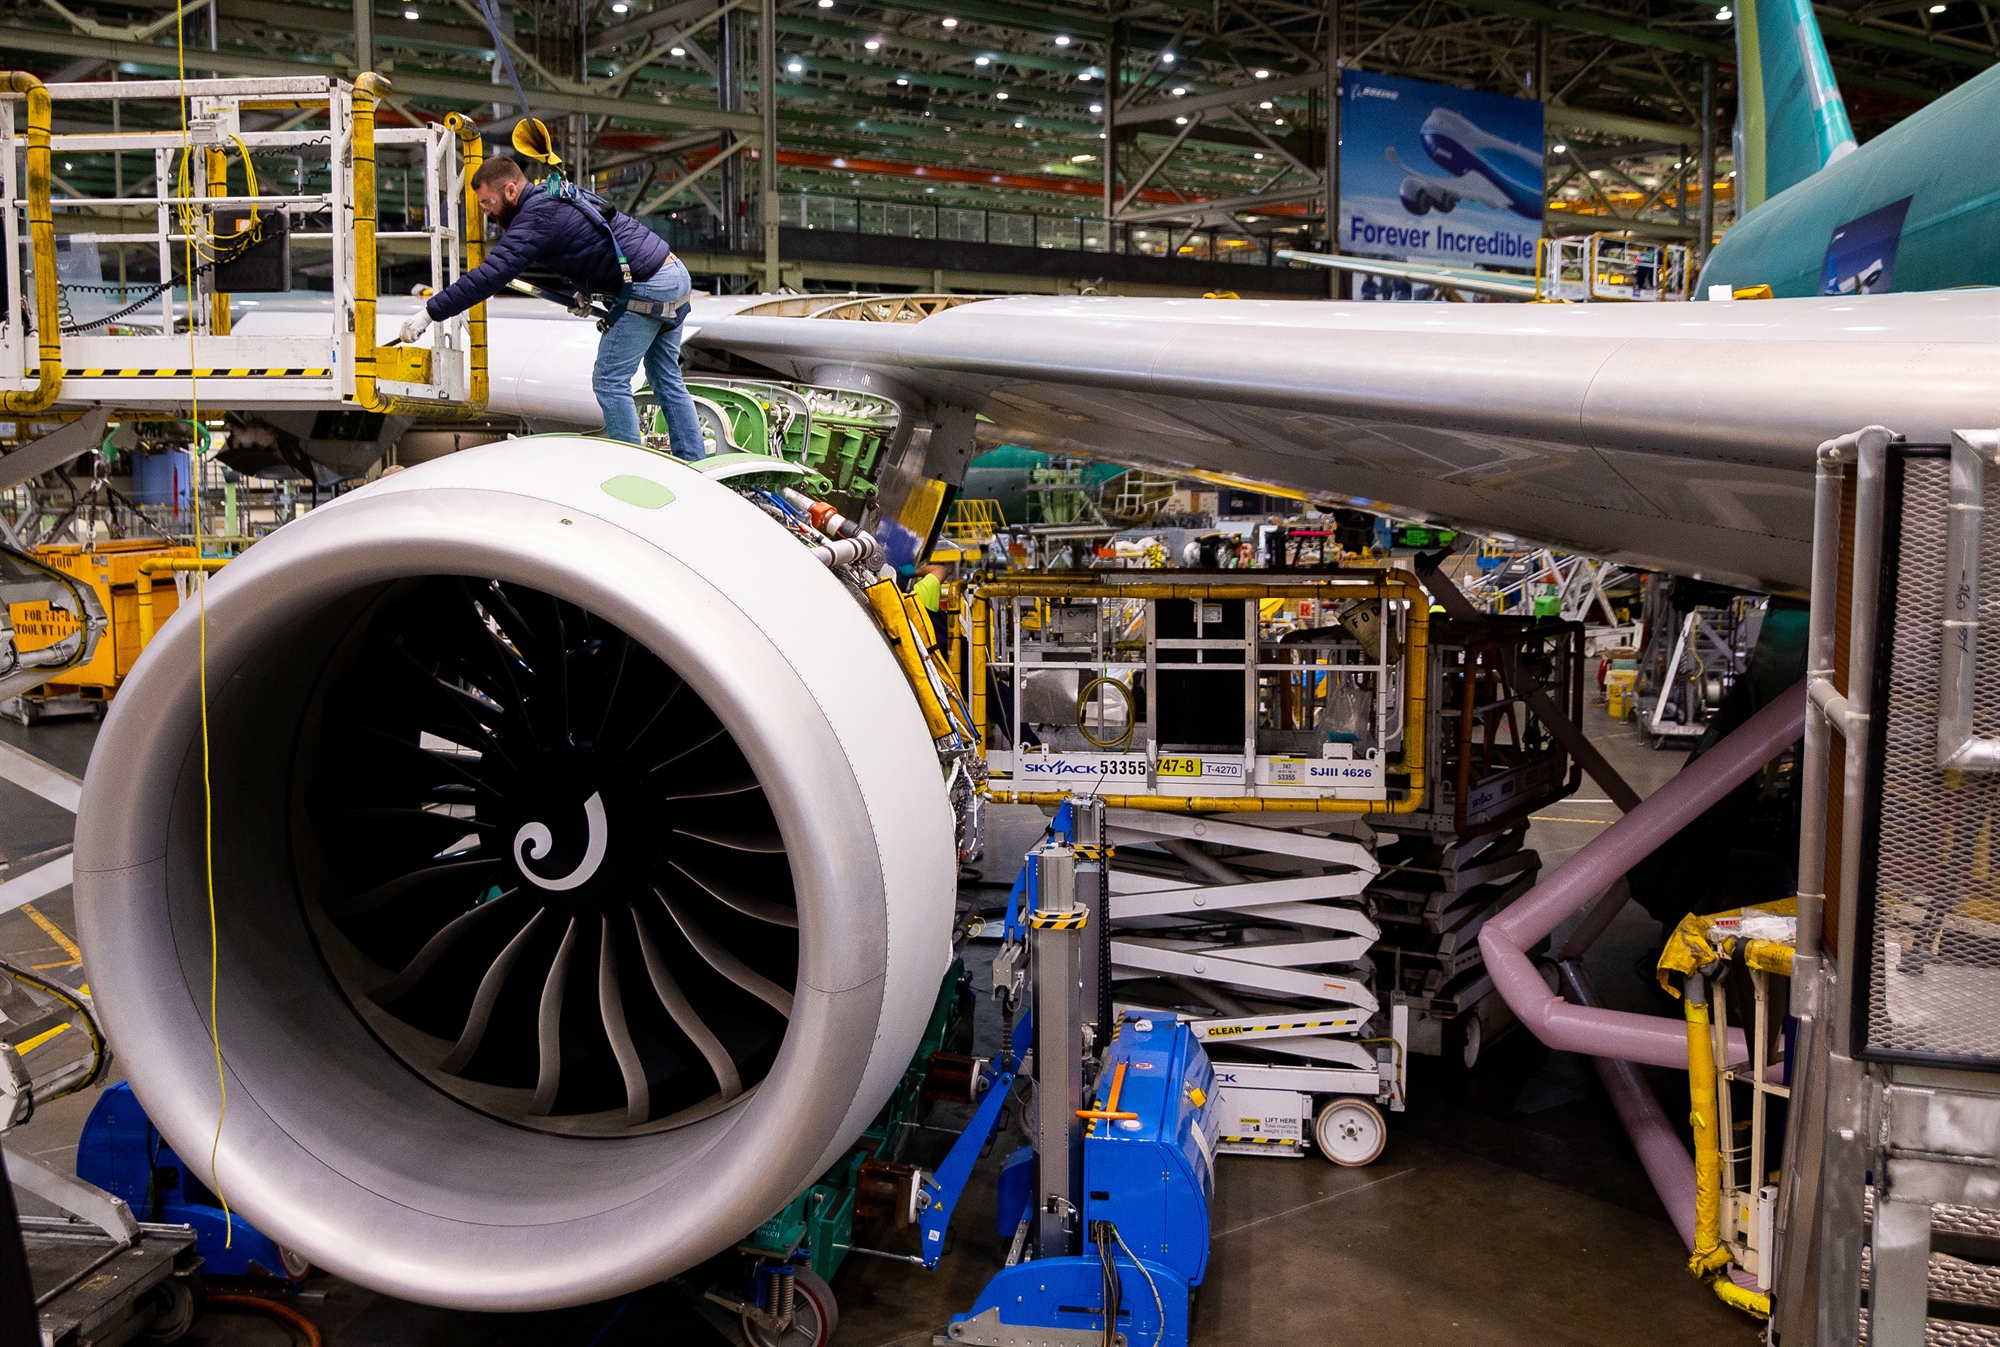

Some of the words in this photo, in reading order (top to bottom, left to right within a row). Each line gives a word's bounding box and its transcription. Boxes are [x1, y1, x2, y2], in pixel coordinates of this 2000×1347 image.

[1351, 216, 1430, 248] Forever
[1436, 225, 1533, 259] Incredible
[24, 609, 42, 621] FOR
[1351, 606, 1380, 629] FOD
[16, 623, 39, 636] TOOL
[40, 624, 54, 637] WT
[1024, 759, 1098, 775] SKYJACK
[1100, 760, 1146, 775] 53355
[1156, 759, 1194, 773] 747-8
[1206, 764, 1238, 775] T-4270
[1342, 768, 1372, 778] 4626
[1277, 773, 1296, 781] 53355
[1208, 1026, 1242, 1036] CLEAR
